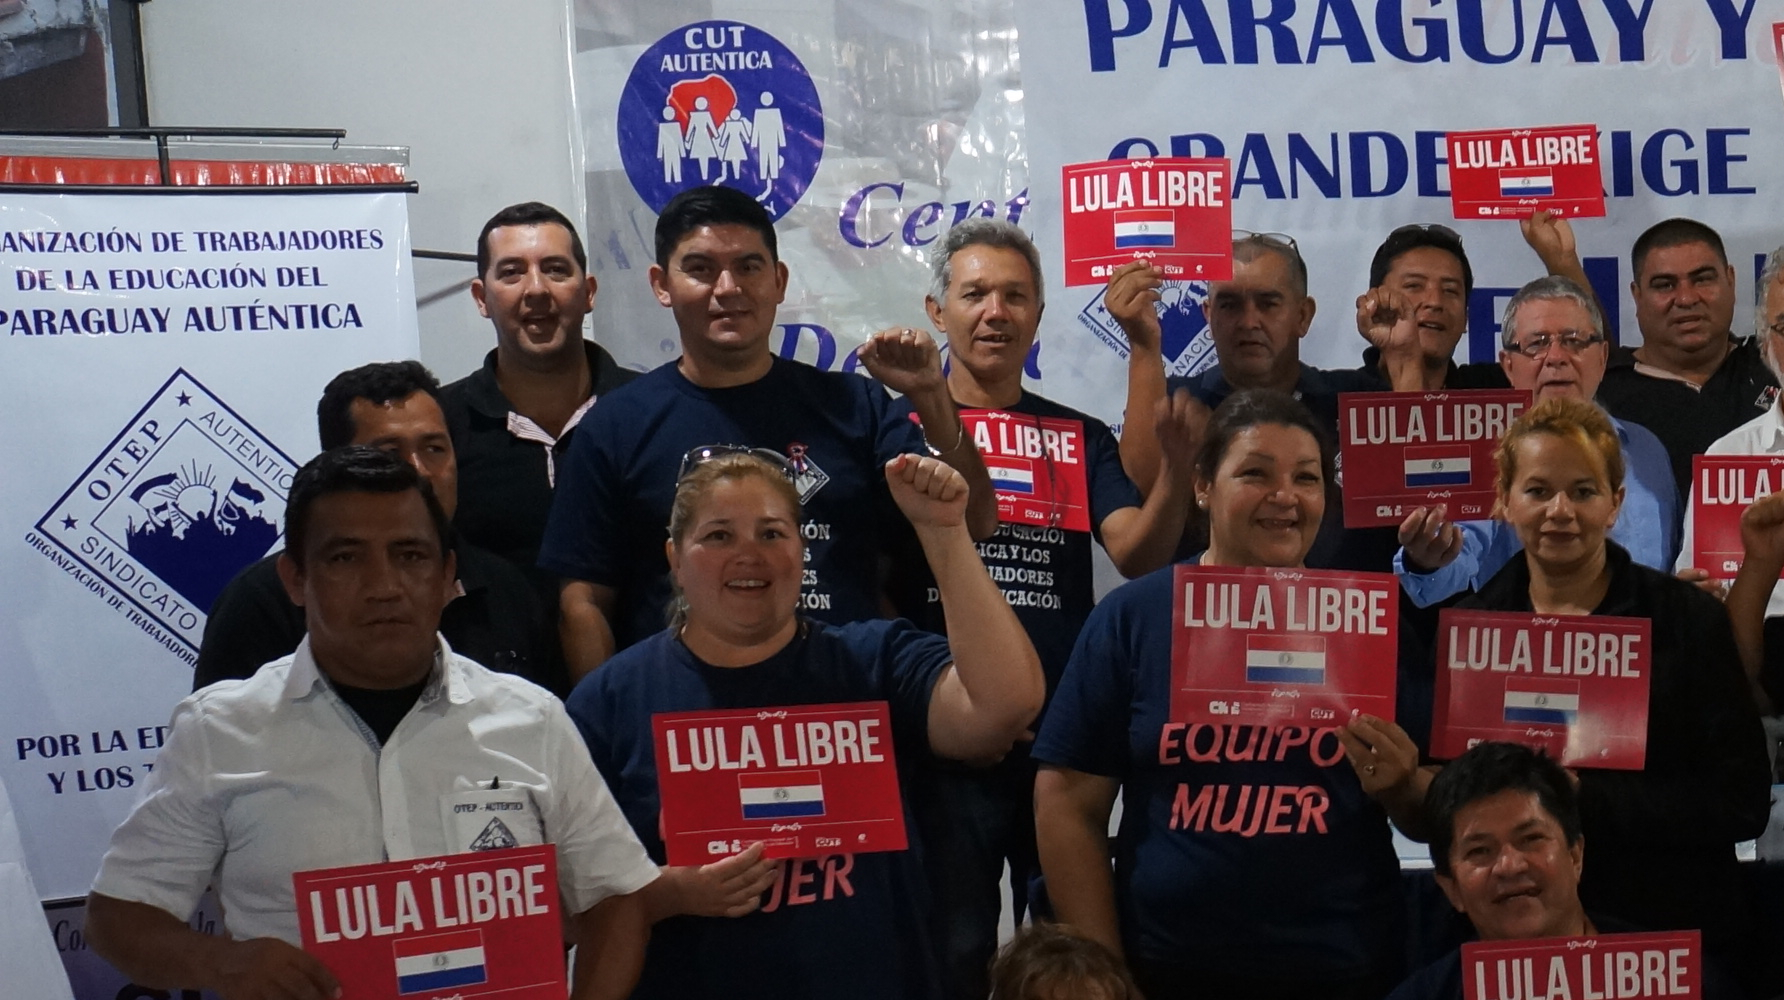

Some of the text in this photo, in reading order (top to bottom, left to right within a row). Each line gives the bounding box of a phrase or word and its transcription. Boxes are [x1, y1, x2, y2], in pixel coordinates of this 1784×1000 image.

[685, 26, 745, 49] CUT
[1710, 0, 1755, 60] Y
[660, 51, 773, 72] AUTENTICA
[1454, 135, 1593, 169] LULA LIBRE
[1070, 170, 1224, 213] LULA LIBRE
[0, 227, 383, 253] ANIZACIÓN DE TRABAJADORES
[16, 262, 328, 291] DE LA EDUCACIÓN DEL
[184, 299, 363, 333] AUTÉNTICA
[1000, 425, 1078, 465] LIBRE
[1349, 405, 1421, 446] LULA
[87, 419, 162, 502] OTEP
[1702, 467, 1769, 505] LULA
[24, 531, 107, 599] ORGANIZACIÓN
[107, 593, 125, 613] DE
[1021, 547, 1052, 564] LOS
[80, 535, 198, 631] SINDICATO
[1185, 582, 1389, 635] LULA LIBRE
[1448, 626, 1642, 679] LULA LIBRE
[16, 733, 82, 760] POR
[91, 730, 129, 754] LA
[666, 718, 884, 773] LULA LIBRE
[1159, 722, 1346, 768] EQUIPO
[47, 765, 135, 794] Y LOS
[1168, 783, 1330, 837] MUJER
[310, 862, 549, 944] LULA LIBRE
